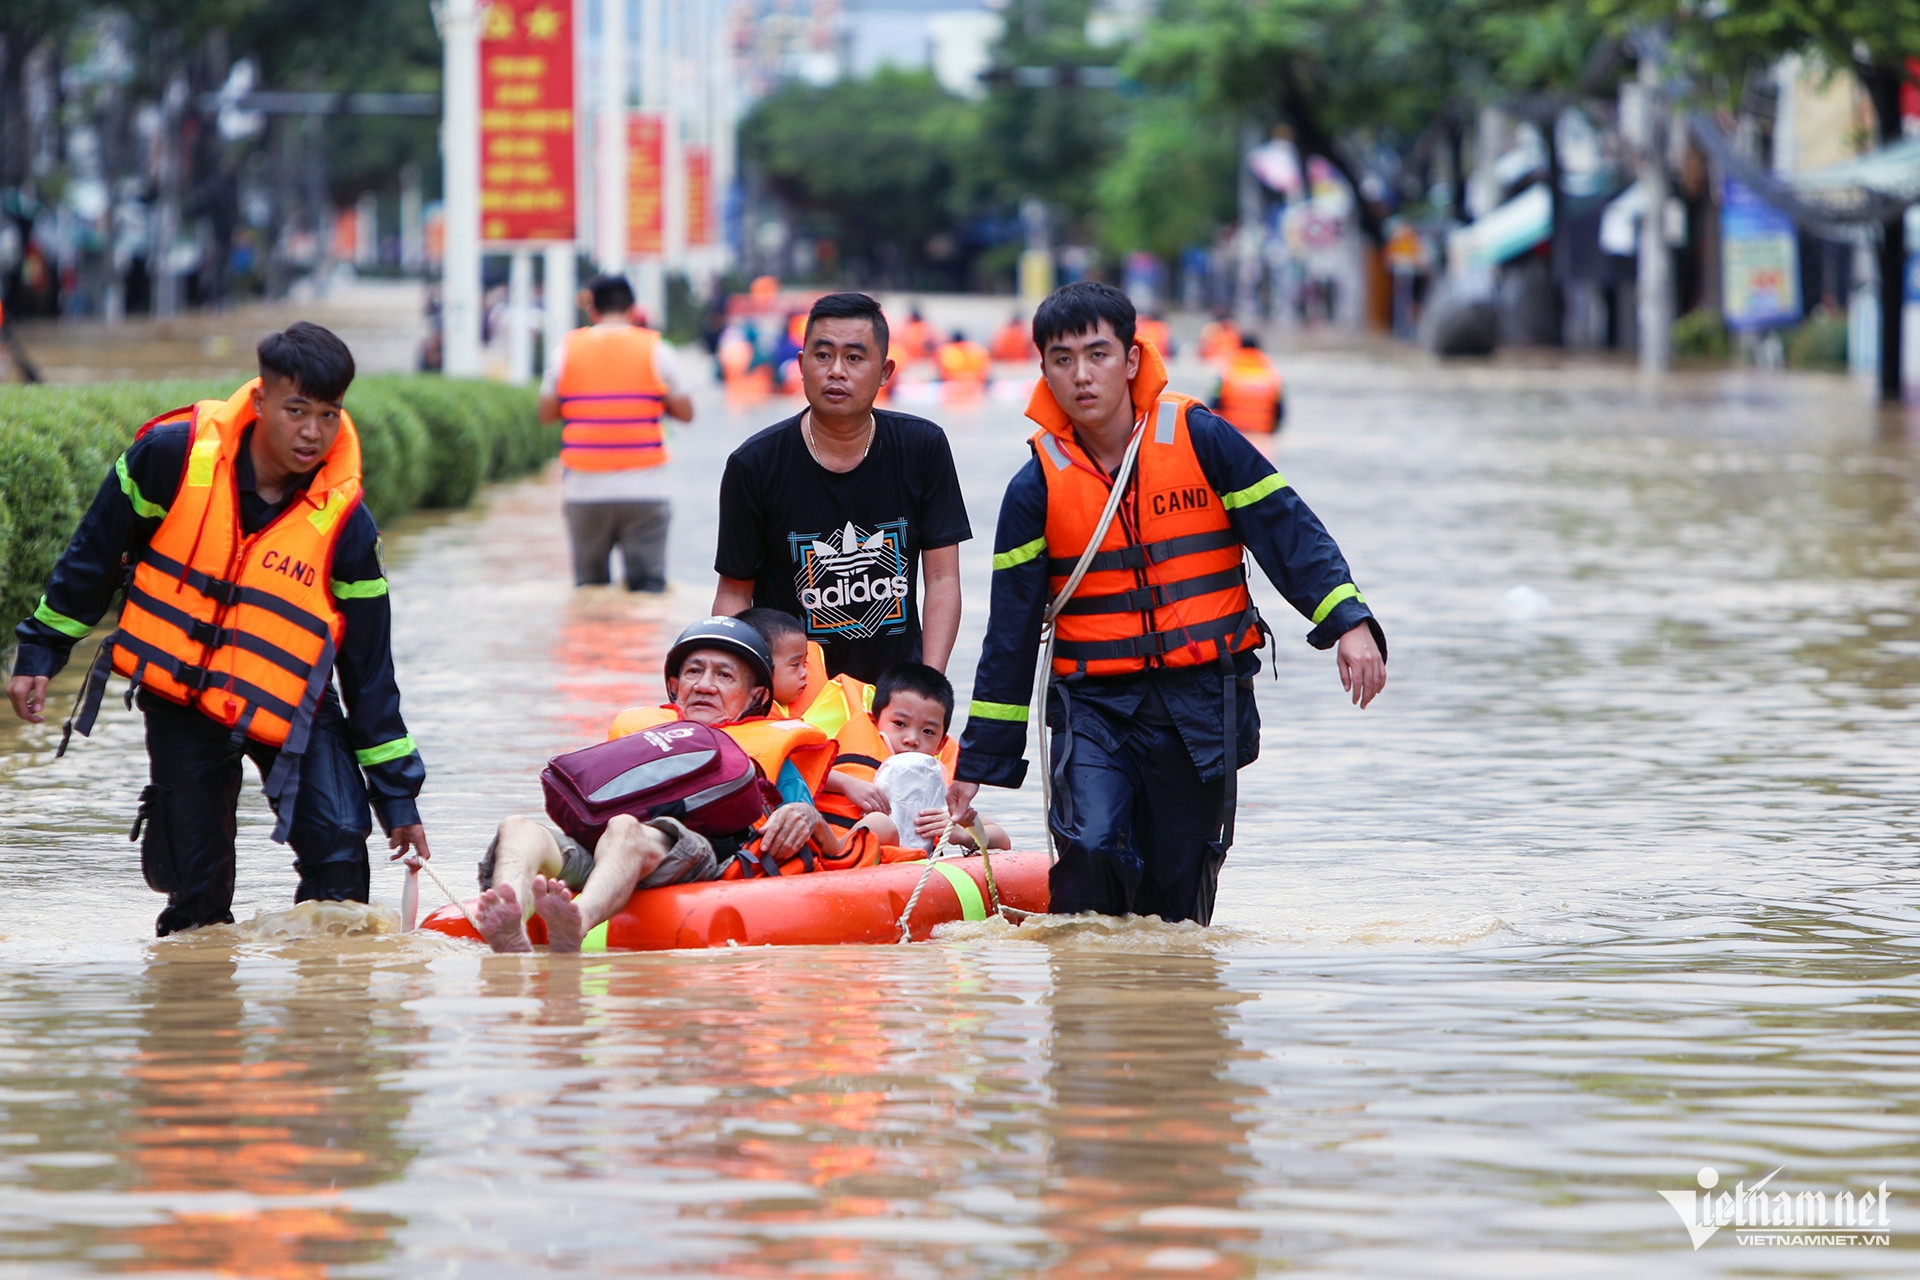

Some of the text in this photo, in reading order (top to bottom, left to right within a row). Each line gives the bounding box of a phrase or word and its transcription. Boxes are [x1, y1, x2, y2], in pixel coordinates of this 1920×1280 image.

[1153, 488, 1208, 515] CAND
[262, 551, 315, 587] CAND
[801, 574, 908, 610] adidas
